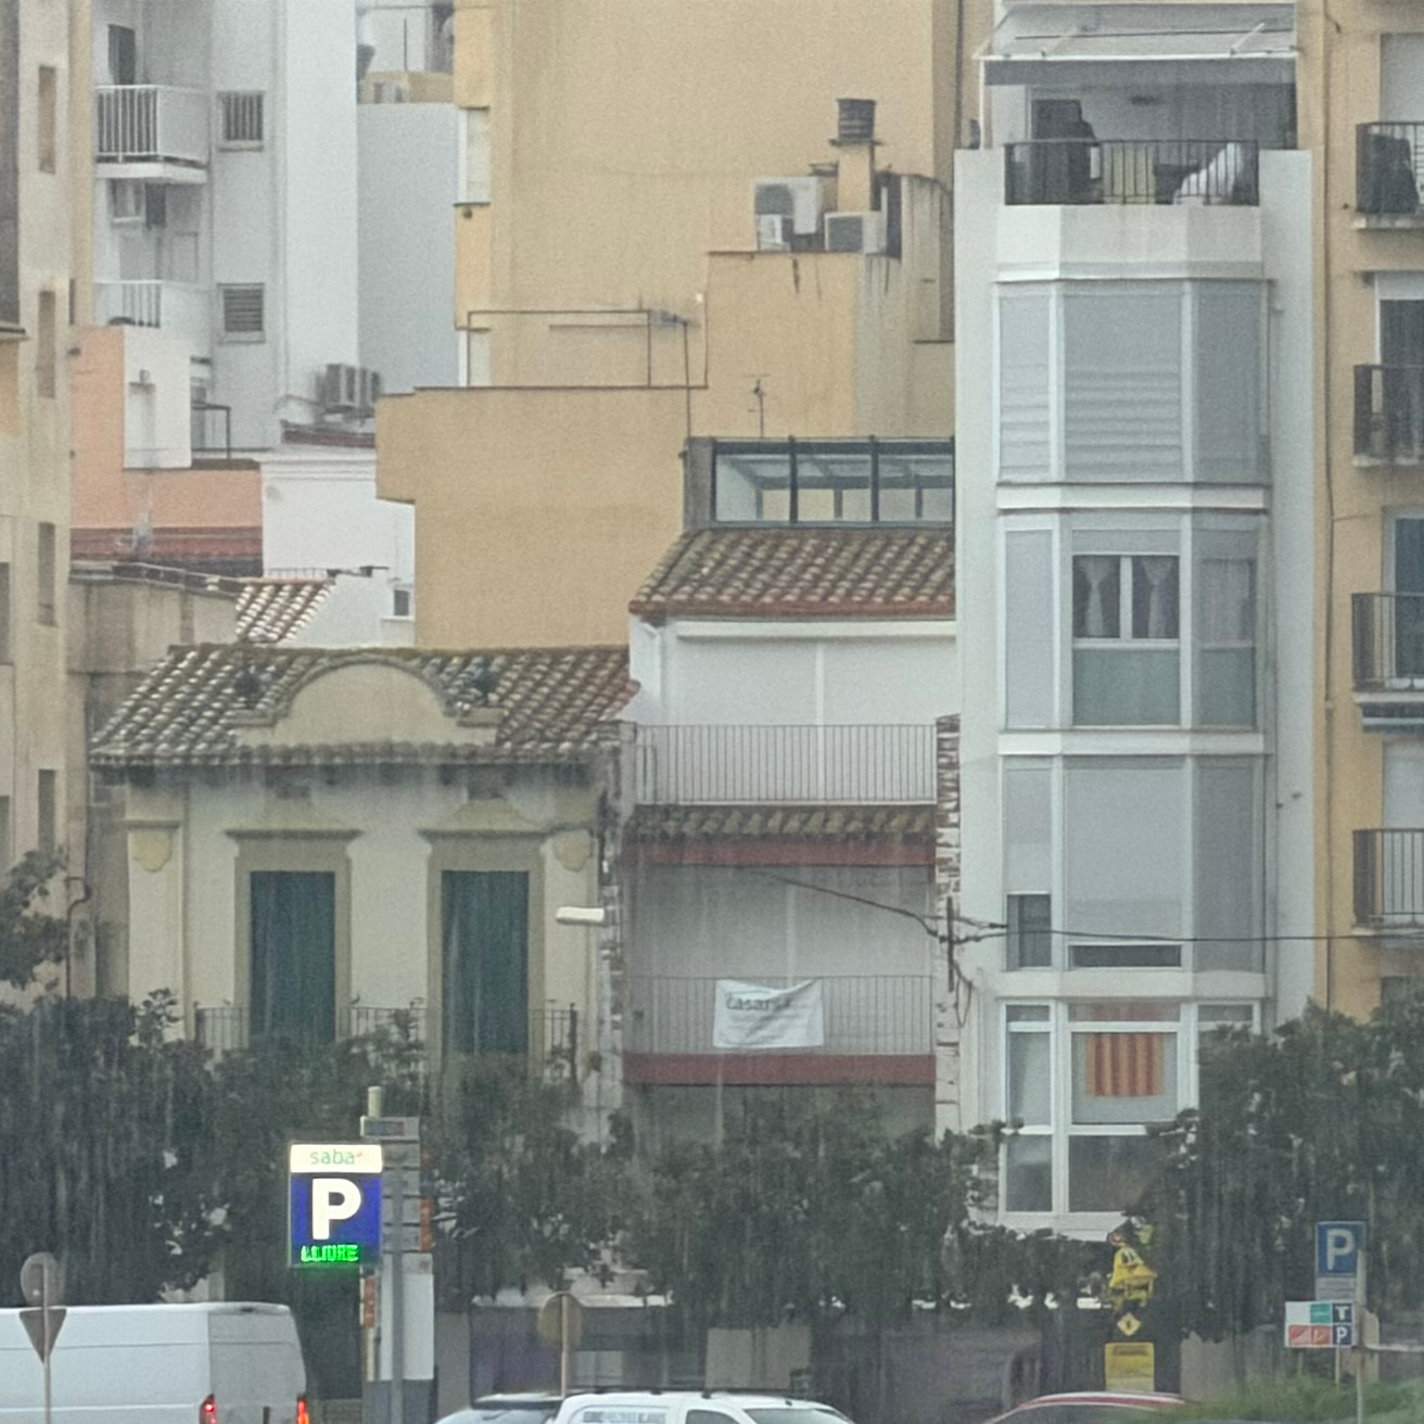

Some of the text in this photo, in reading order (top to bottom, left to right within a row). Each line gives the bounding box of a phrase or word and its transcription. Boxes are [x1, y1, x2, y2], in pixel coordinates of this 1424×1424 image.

[309, 1149, 356, 1166] saba
[312, 1178, 361, 1240] P
[1326, 1228, 1355, 1270] P
